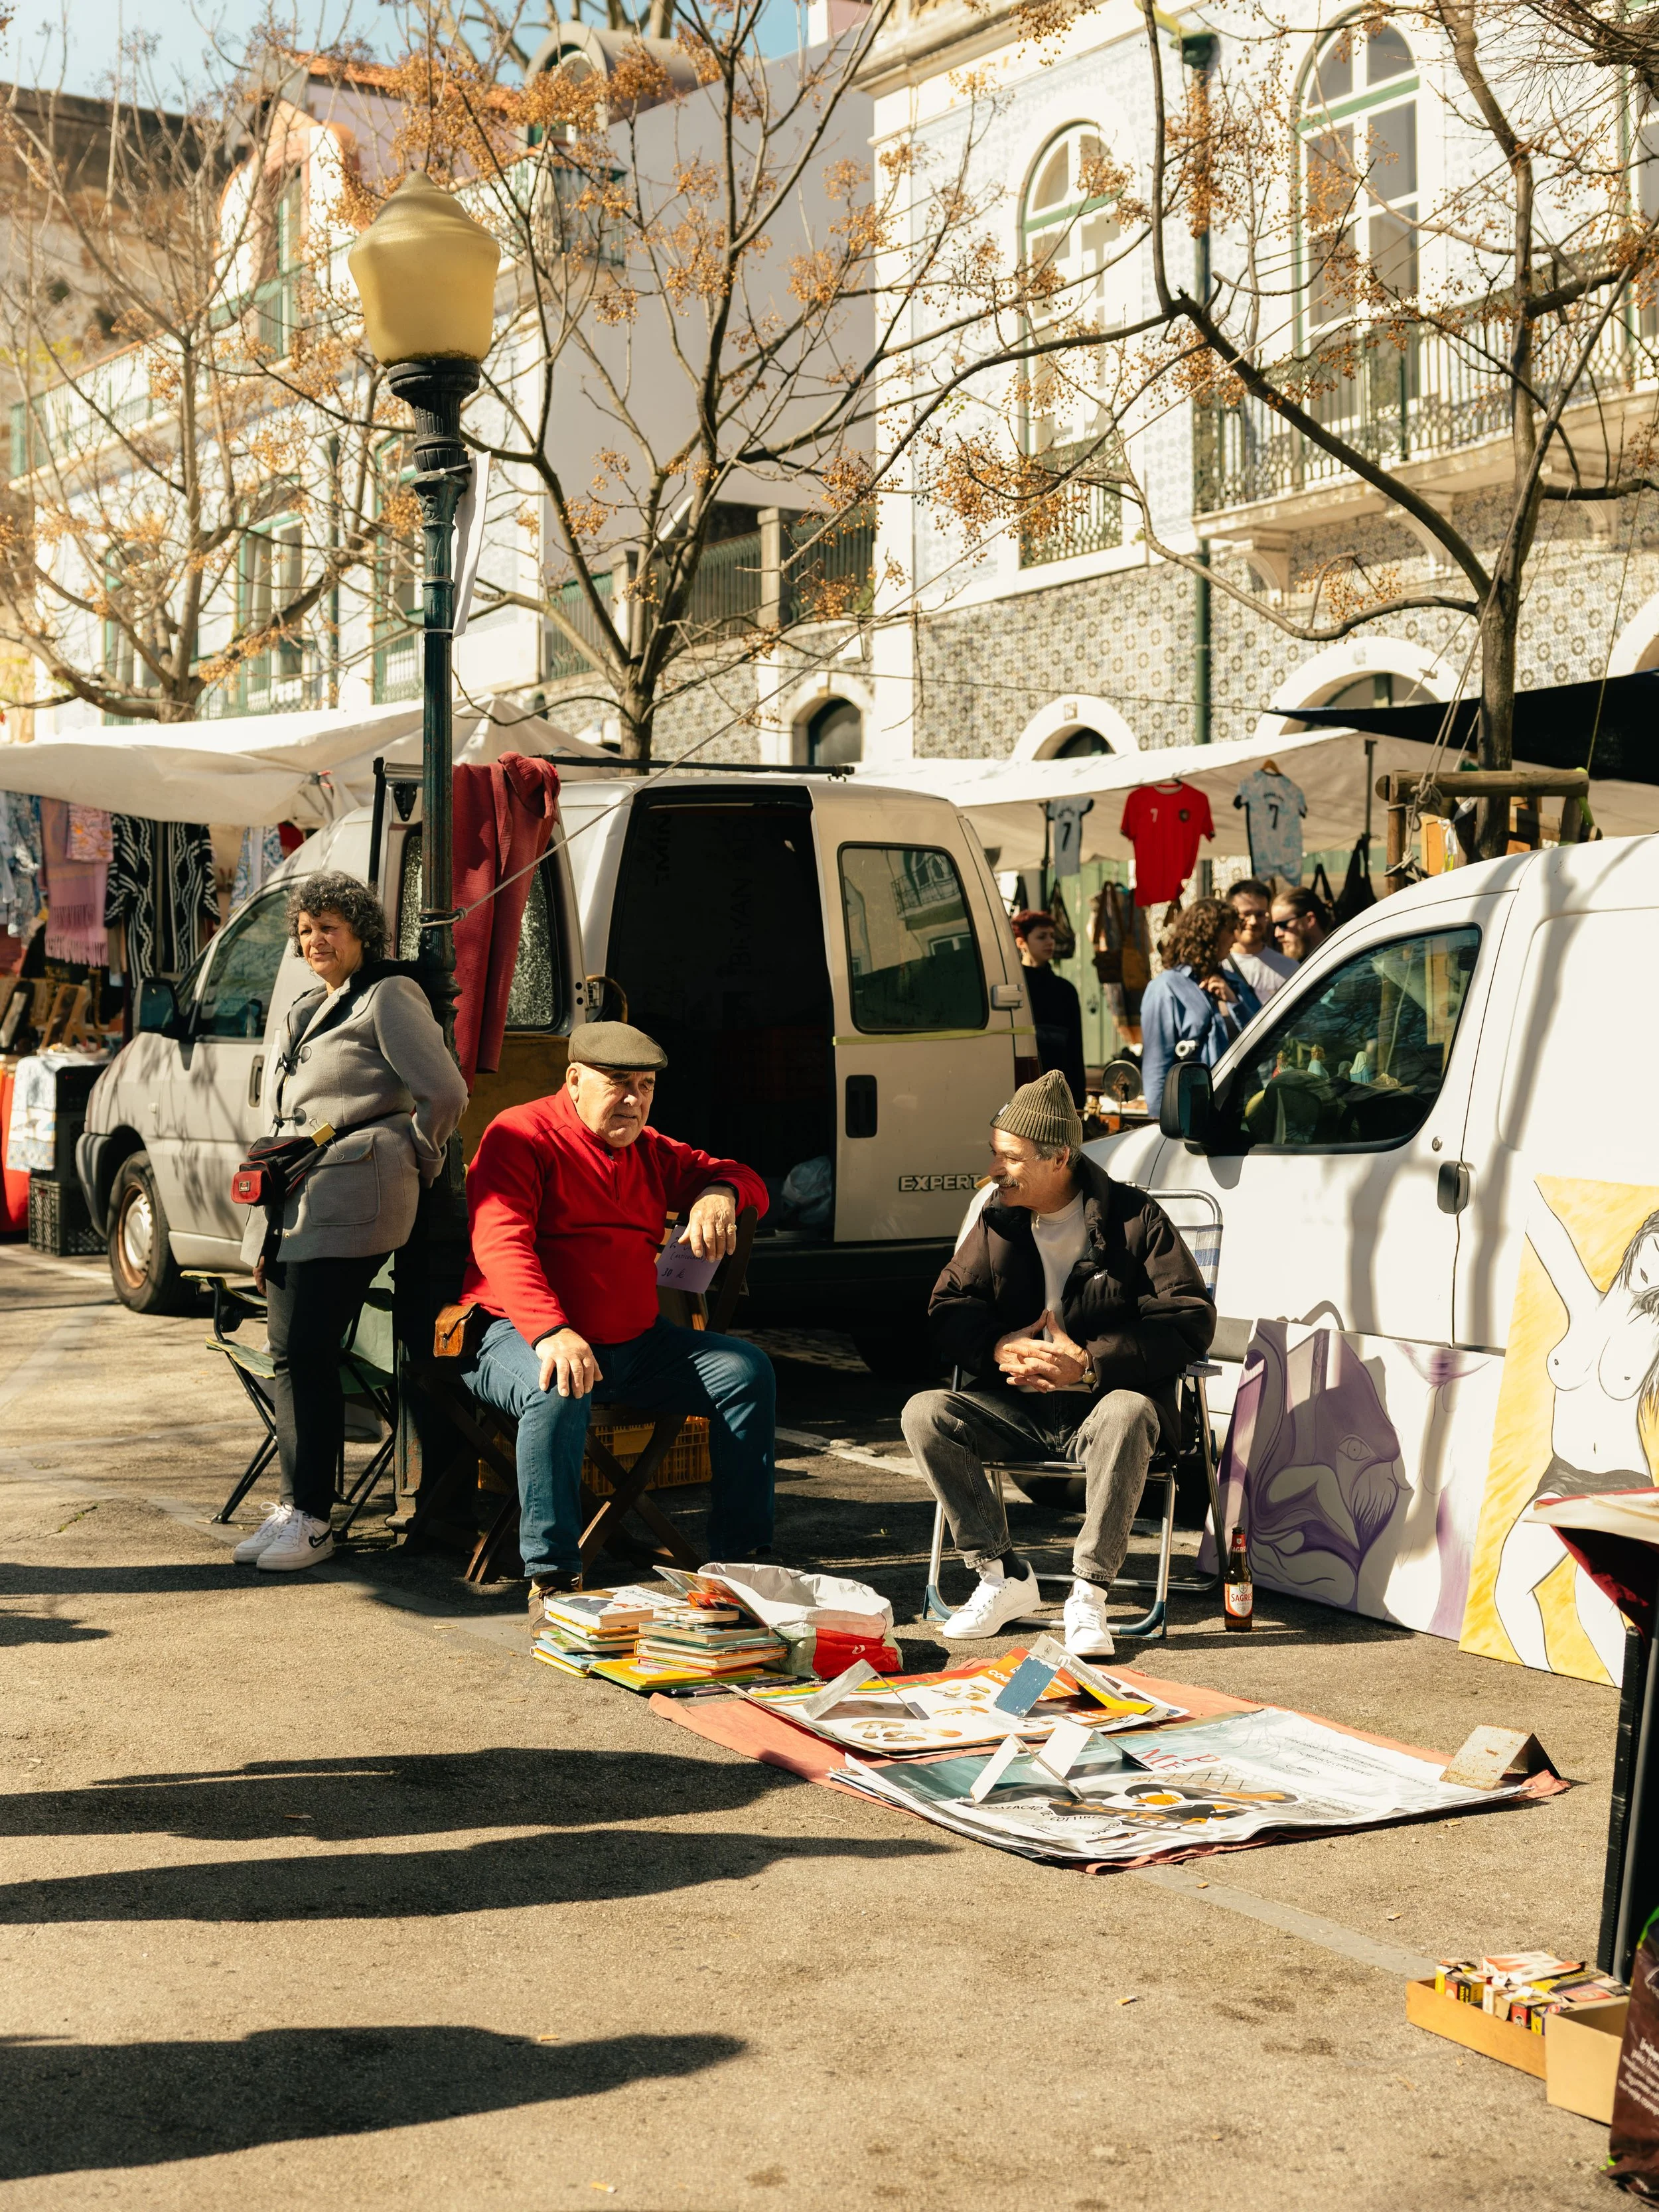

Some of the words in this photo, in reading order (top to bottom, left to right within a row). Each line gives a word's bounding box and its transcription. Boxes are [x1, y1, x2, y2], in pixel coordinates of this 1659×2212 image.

[1150, 808, 1158, 823] 7
[1268, 803, 1279, 830] 7
[1062, 822, 1072, 851] 7
[899, 1173, 981, 1192] EXPERT
[662, 1267, 673, 1277] 30
